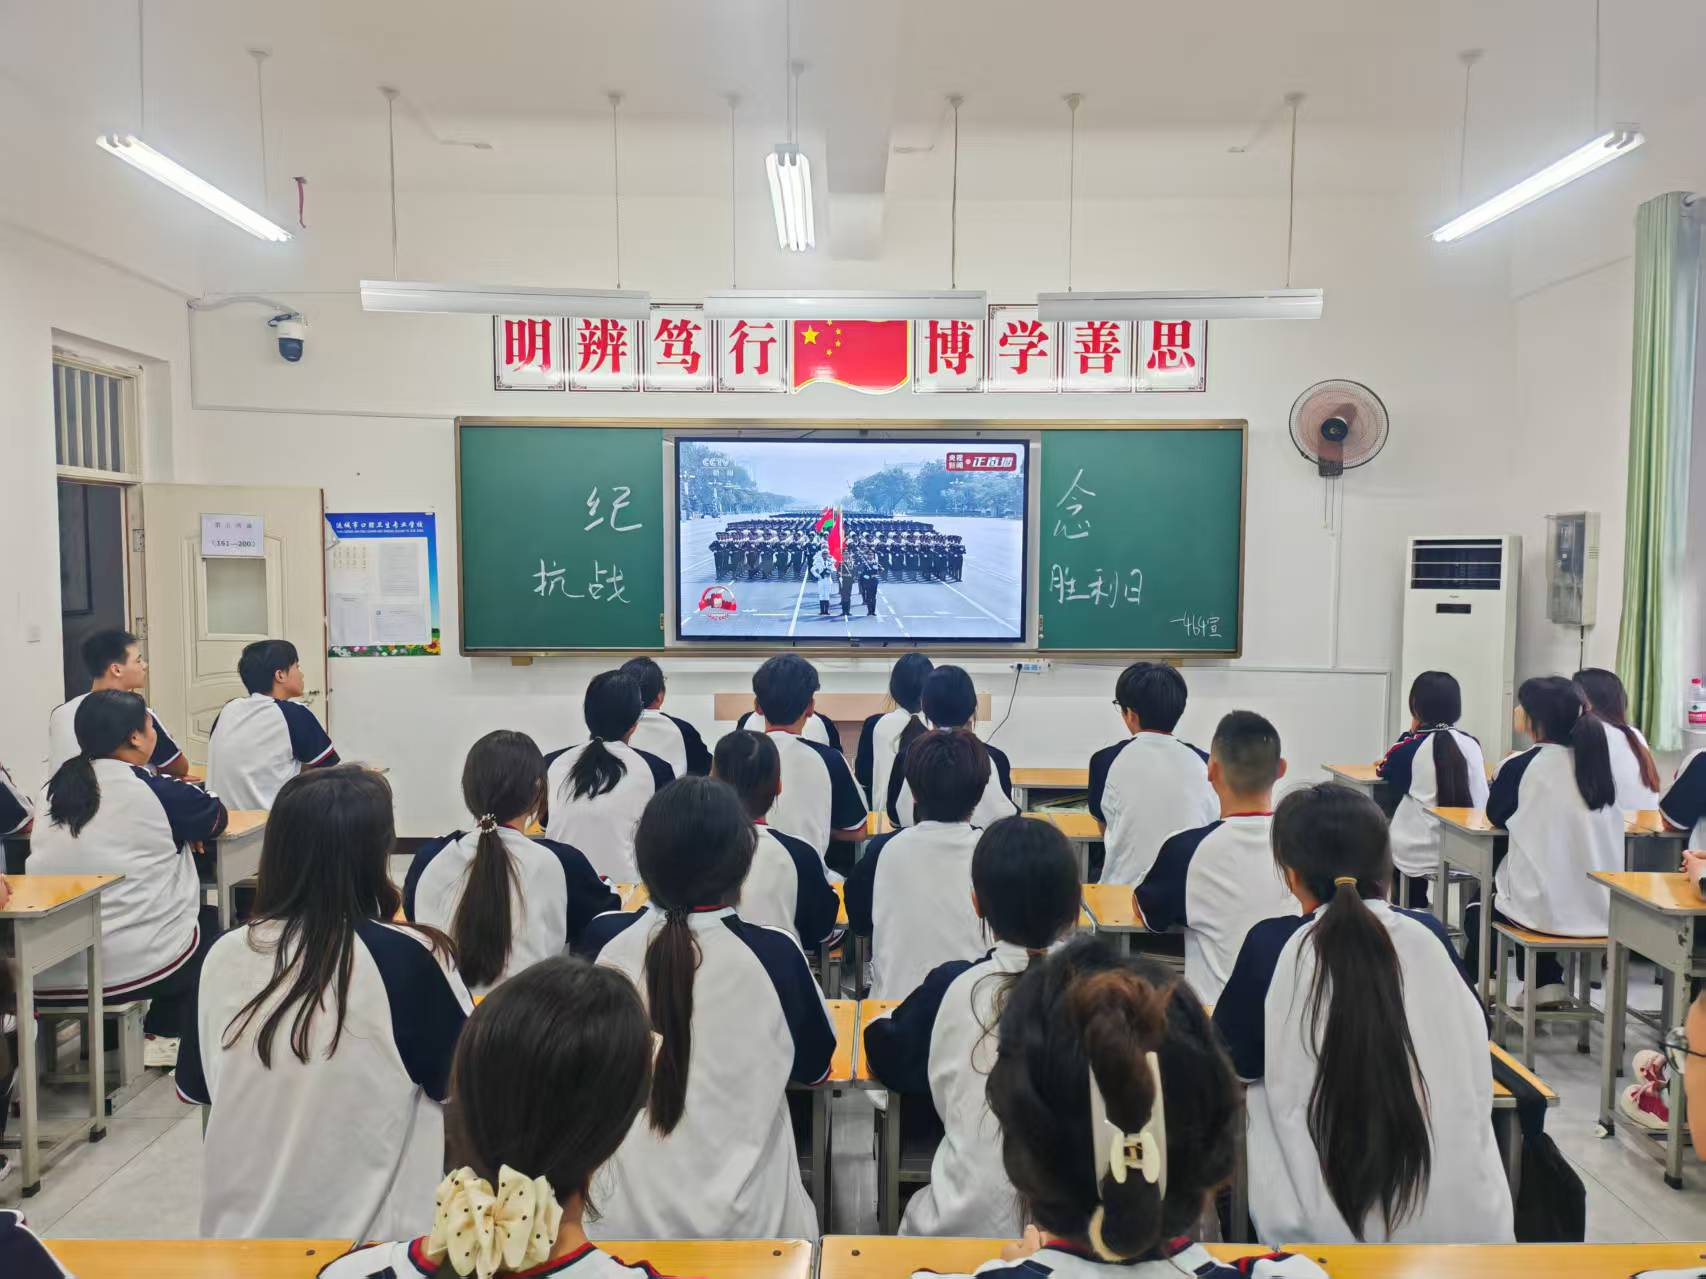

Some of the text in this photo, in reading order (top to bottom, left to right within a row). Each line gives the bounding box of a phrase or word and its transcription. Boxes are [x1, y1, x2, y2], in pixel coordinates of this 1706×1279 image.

[505, 318, 1196, 375] 明辨笃行 博学善思
[584, 468, 1096, 539] 纪 念
[532, 558, 1143, 608] 抗战 胜利日
